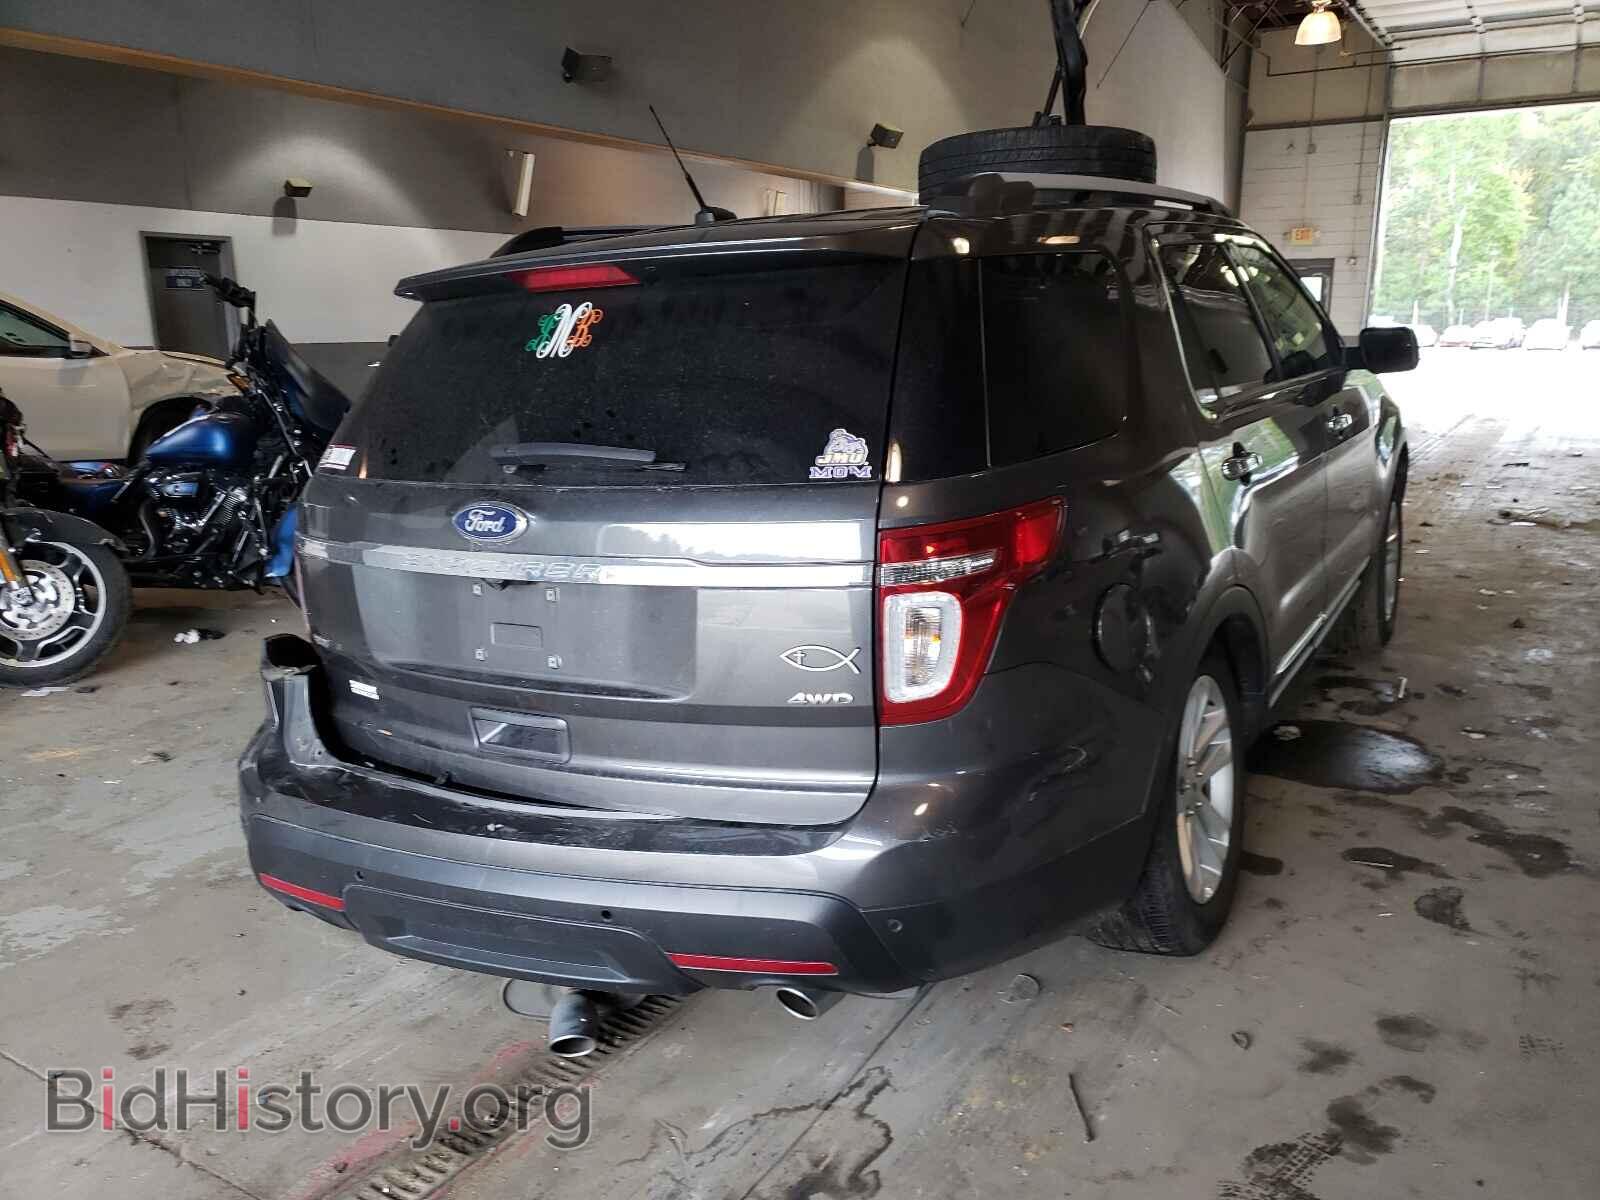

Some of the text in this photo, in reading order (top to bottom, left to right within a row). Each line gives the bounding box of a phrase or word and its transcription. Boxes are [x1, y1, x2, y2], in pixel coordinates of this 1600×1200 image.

[809, 466, 872, 478] MOM
[464, 509, 505, 532] Ford
[787, 692, 854, 704] 4WD
